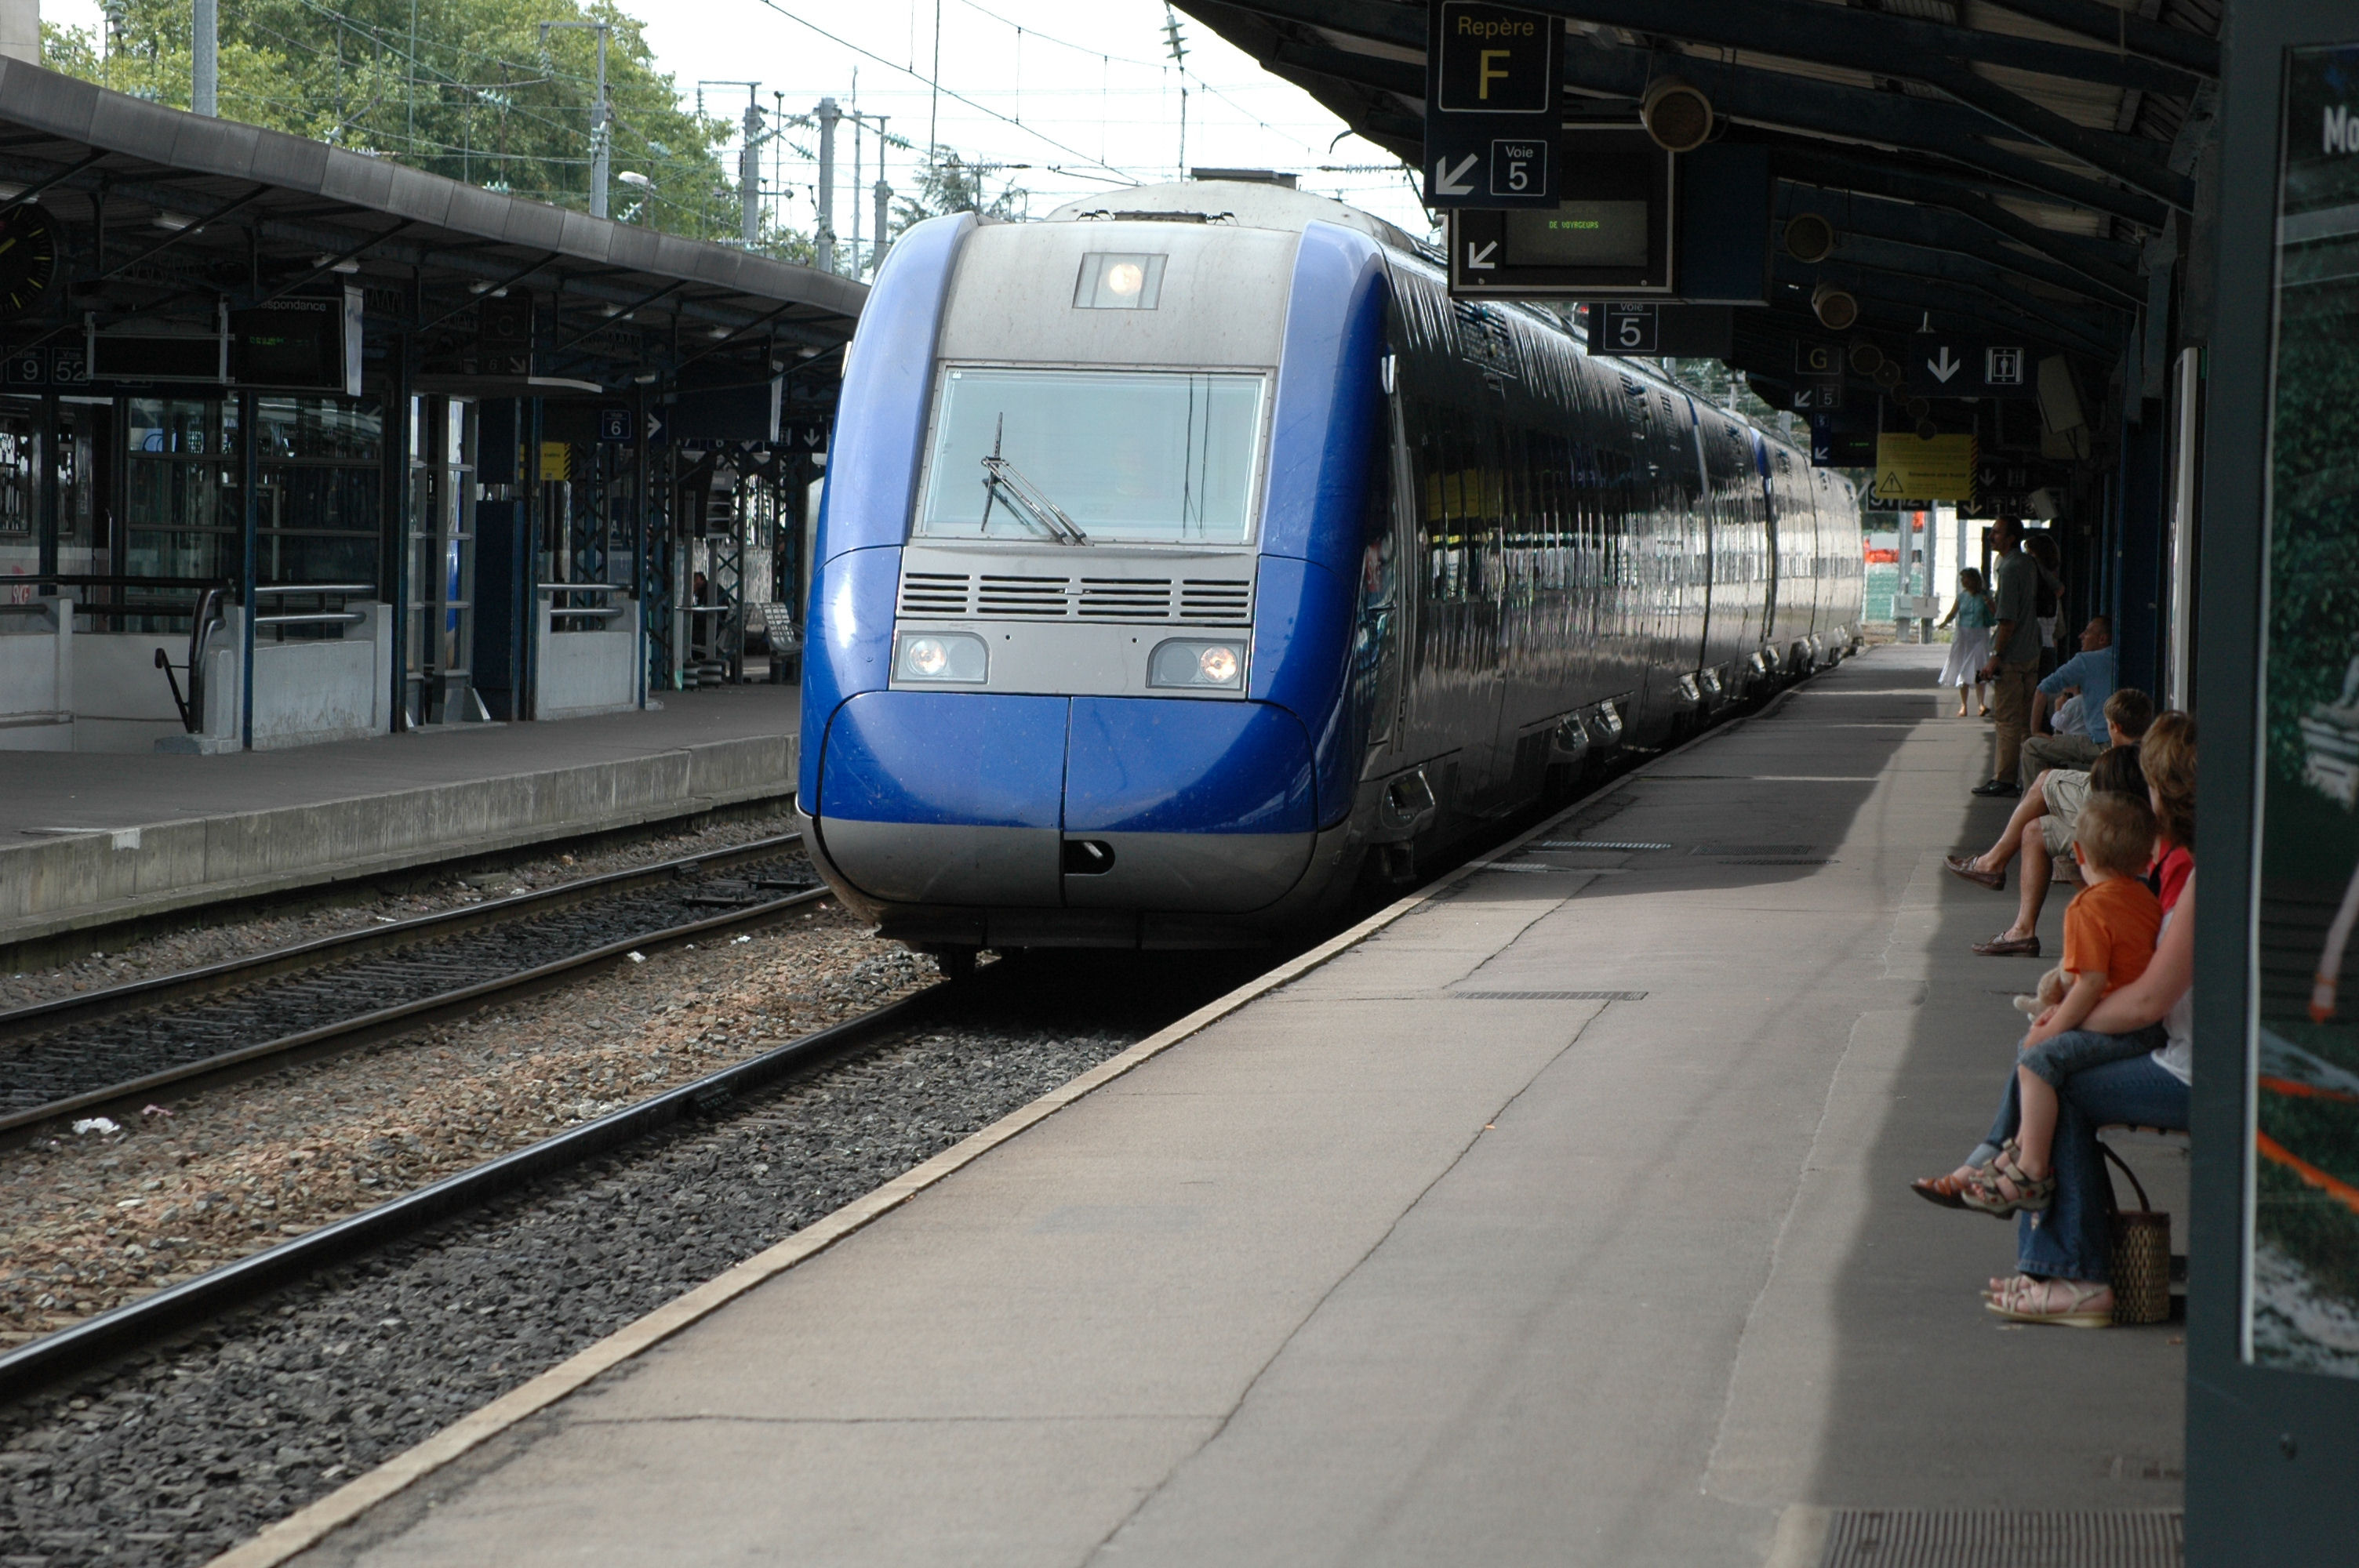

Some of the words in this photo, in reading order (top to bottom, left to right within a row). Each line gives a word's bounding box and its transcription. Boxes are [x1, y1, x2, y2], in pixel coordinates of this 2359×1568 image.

[1458, 16, 1535, 40] Repère
[1479, 49, 1510, 100] F
[1506, 145, 1534, 158] Voie
[1508, 162, 1528, 191] 5
[1549, 220, 1558, 229] DE
[1619, 318, 1641, 347] 5
[1810, 349, 1827, 368] G
[22, 360, 38, 381] 9
[1824, 393, 1833, 405] 5
[611, 421, 621, 435] 6
